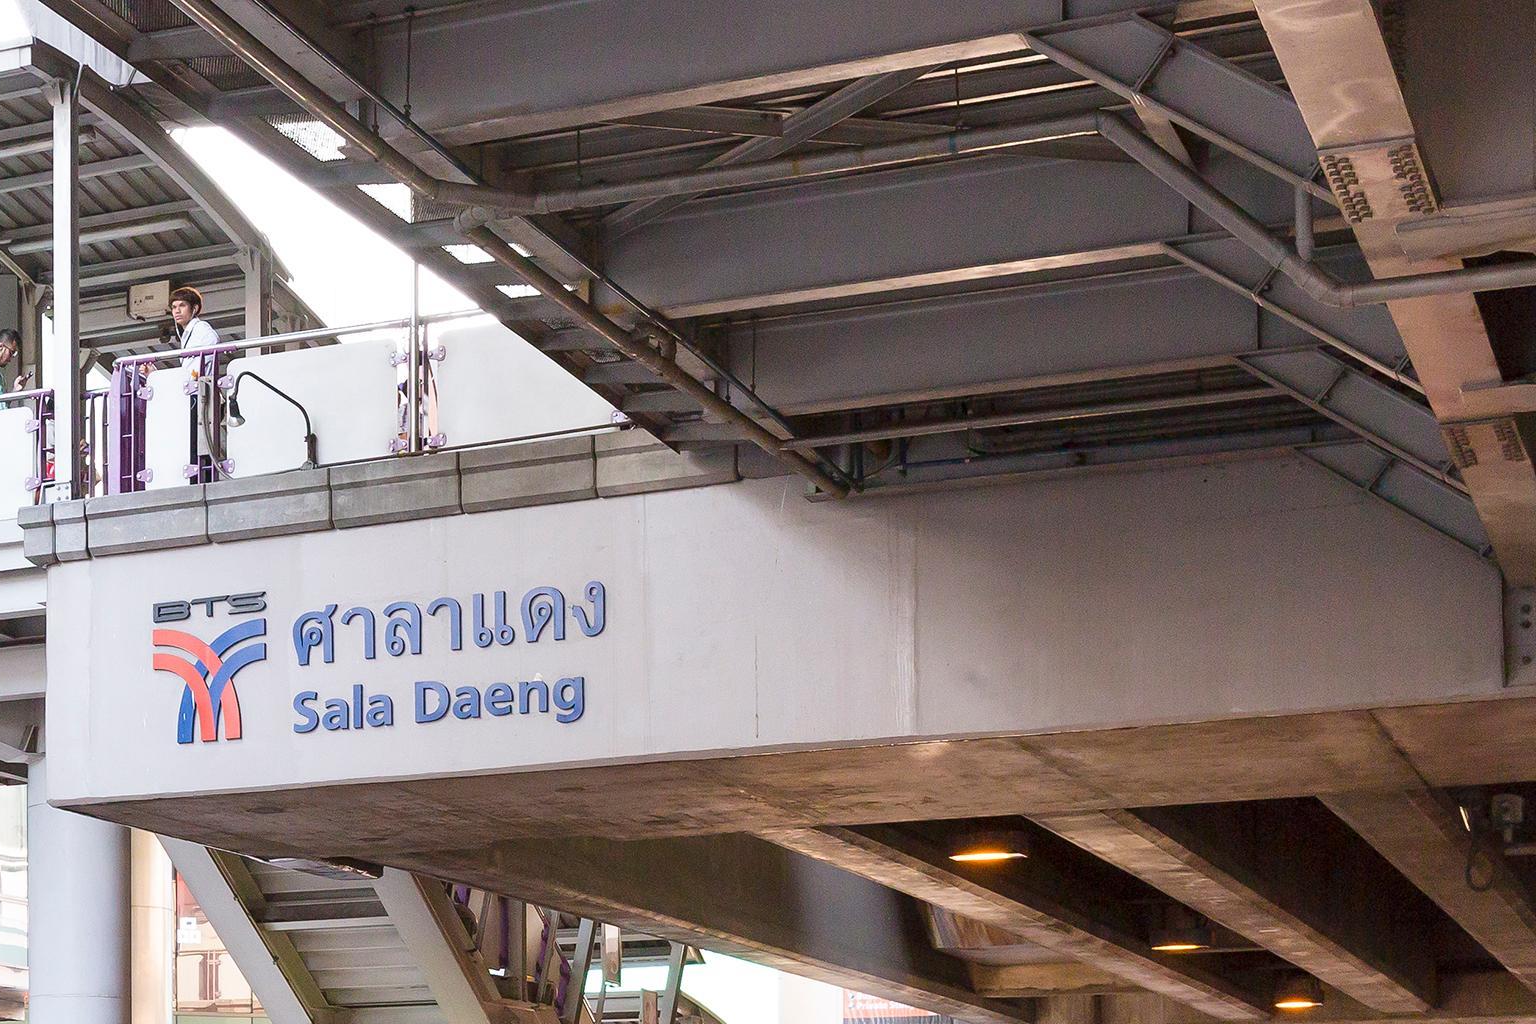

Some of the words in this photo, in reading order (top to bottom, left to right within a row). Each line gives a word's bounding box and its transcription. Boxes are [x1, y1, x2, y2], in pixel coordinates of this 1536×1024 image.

[152, 590, 267, 624] BTS
[291, 579, 607, 667] ศาลาแดง
[292, 683, 395, 735] Sala
[413, 674, 586, 724] Daeng
